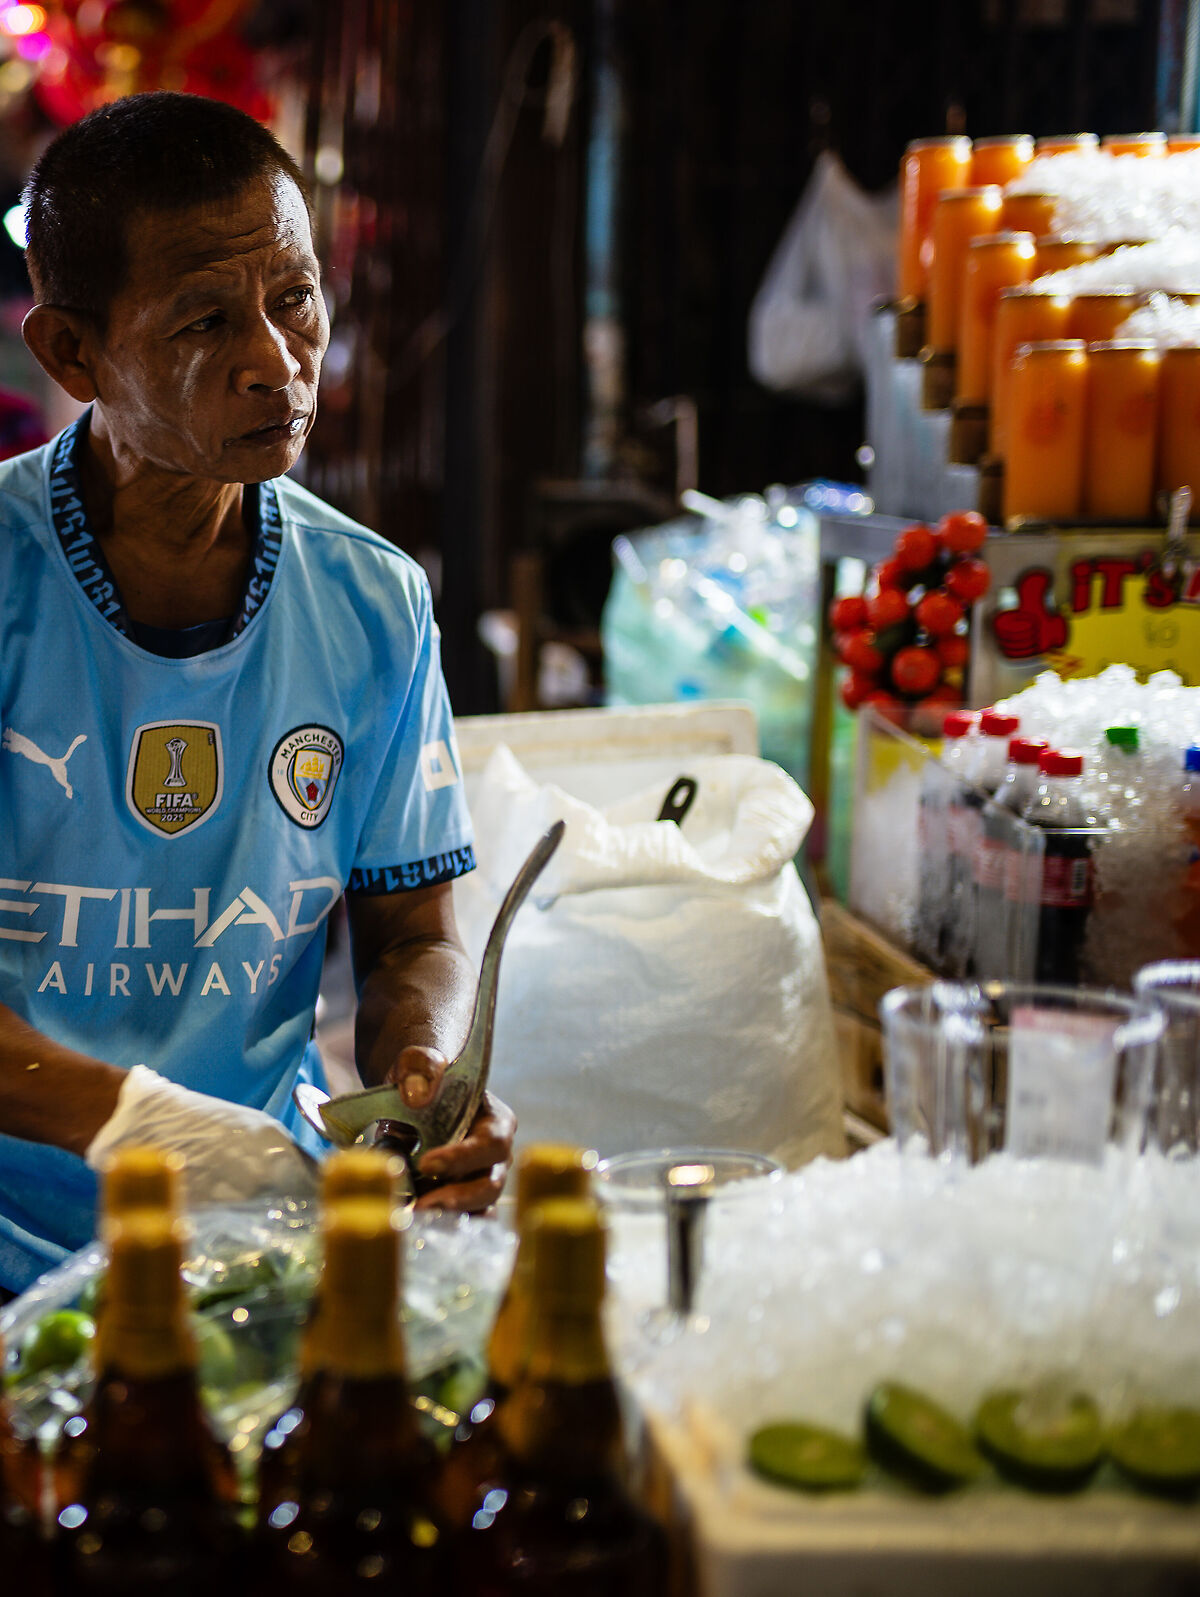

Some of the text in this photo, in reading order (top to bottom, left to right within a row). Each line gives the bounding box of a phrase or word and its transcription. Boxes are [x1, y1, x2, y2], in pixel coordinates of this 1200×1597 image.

[161, 814, 184, 822] 2025
[301, 811, 318, 821] CITY
[37, 954, 283, 996] AIRWAYS
